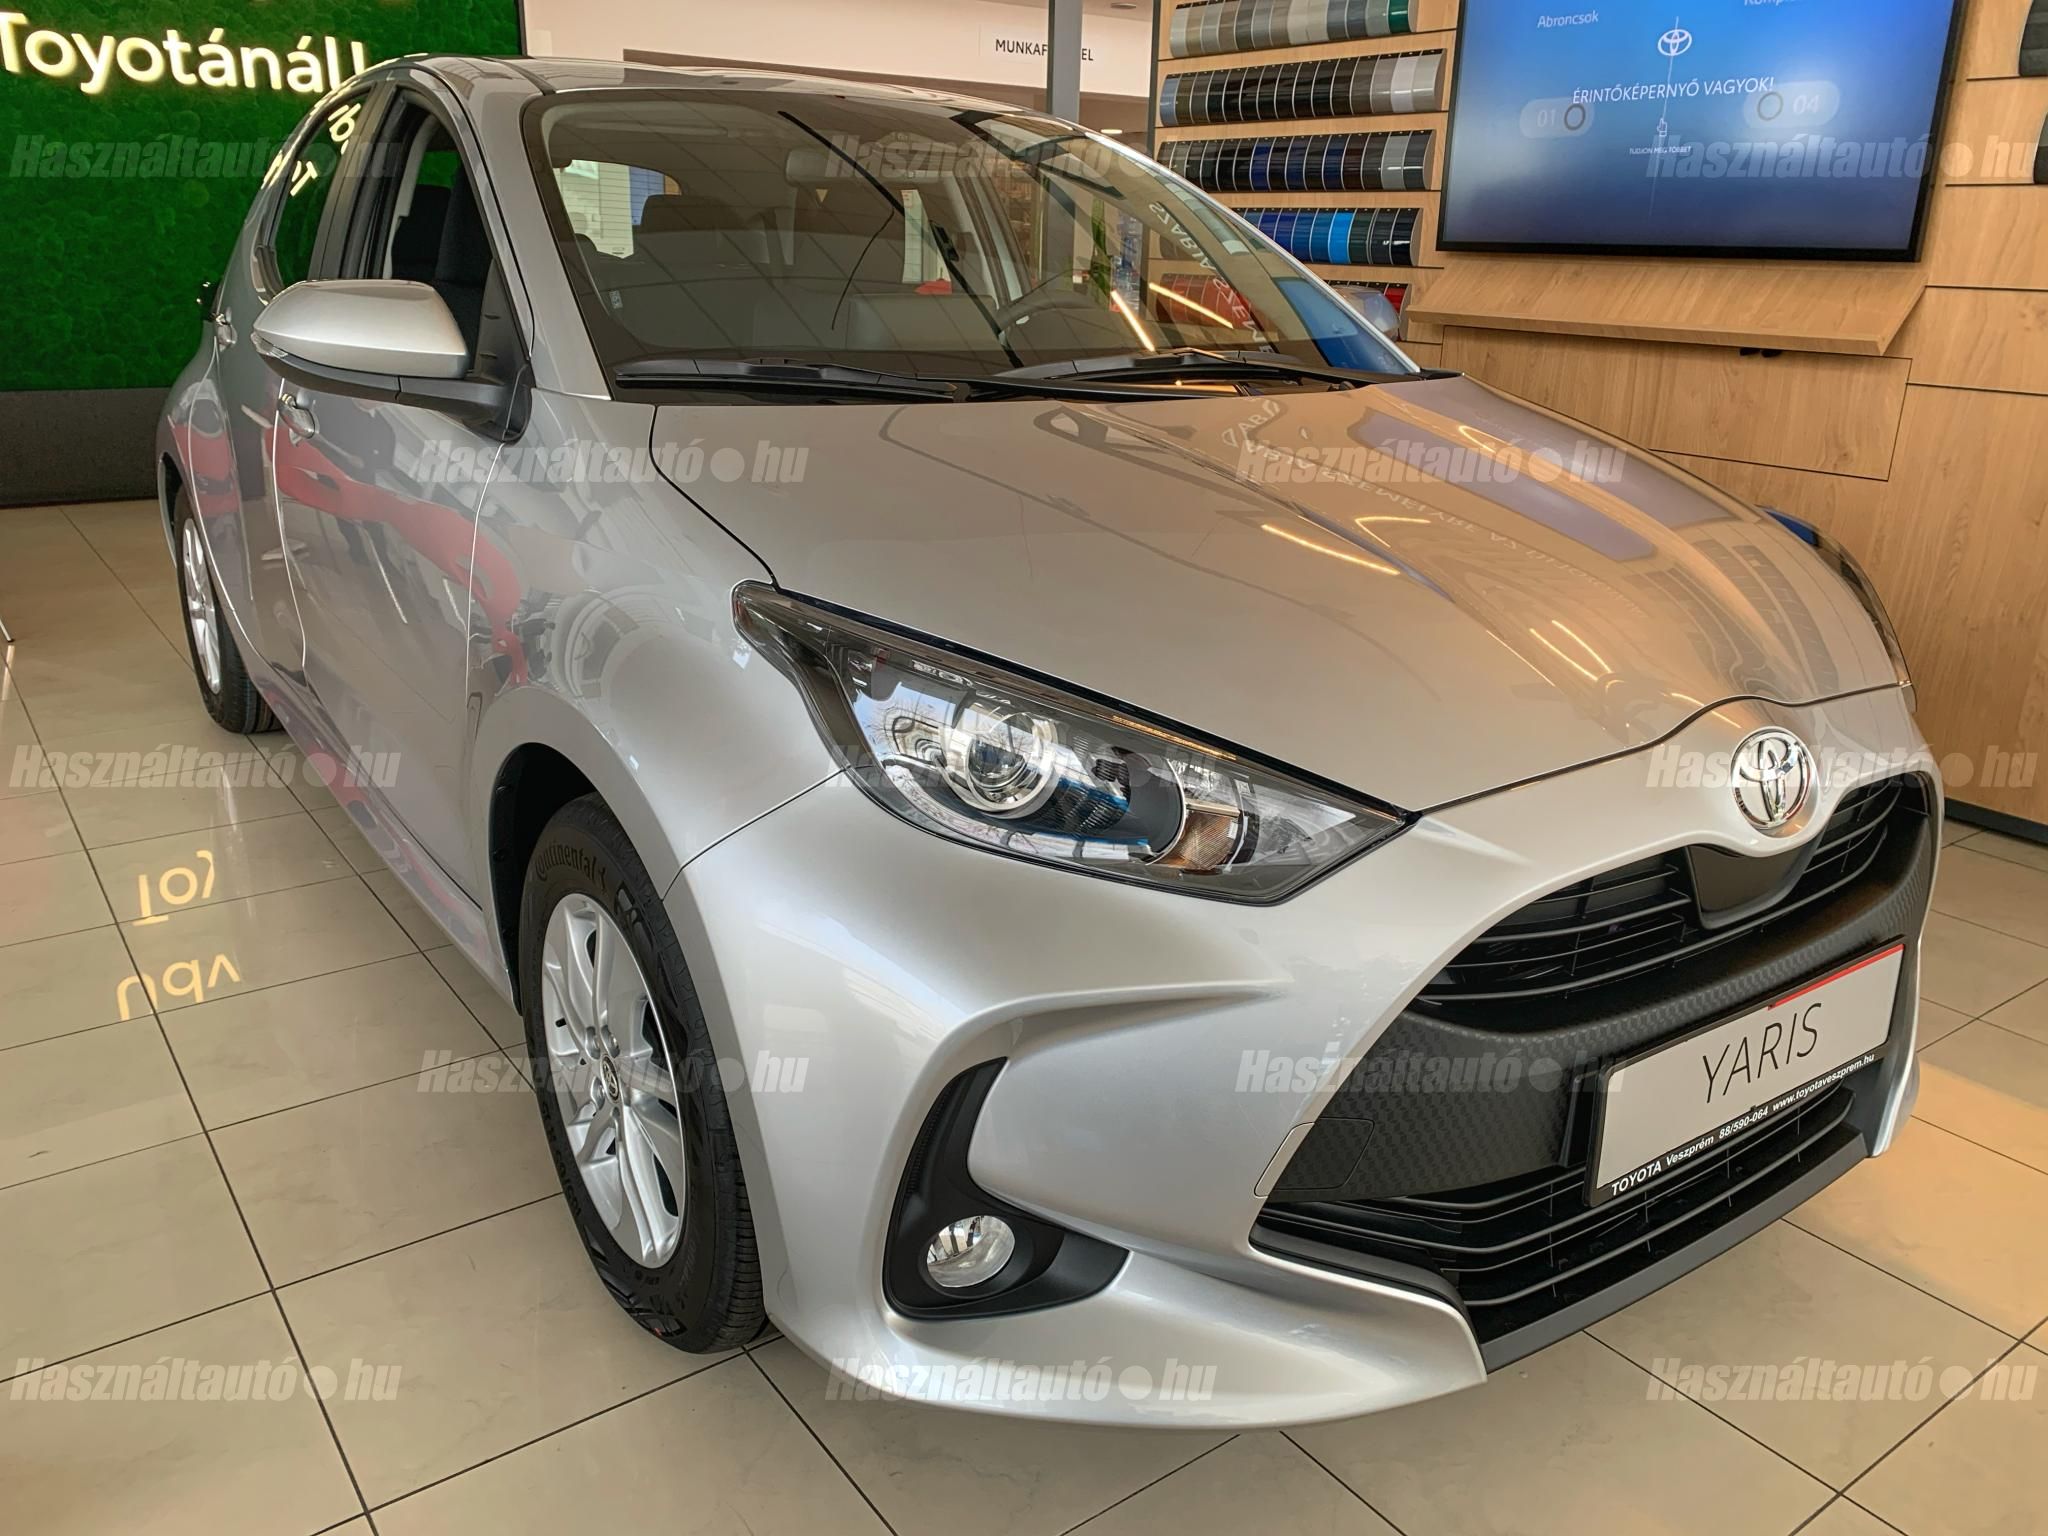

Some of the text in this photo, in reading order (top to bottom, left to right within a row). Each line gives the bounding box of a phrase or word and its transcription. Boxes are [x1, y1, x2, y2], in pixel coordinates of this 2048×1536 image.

[1537, 10, 1599, 28] Abroncsok
[1573, 76, 1775, 105] ÉRINTŐKÉPERNYŐ VAGYOK!
[1792, 94, 1820, 115] 04
[1536, 109, 1557, 128] 01
[535, 840, 597, 883] Continental
[1702, 1002, 1823, 1104] YARIS
[1611, 1053, 1875, 1197] TOYOTA Veszprém 88/590-064 www.toyotaveszprem.hu
